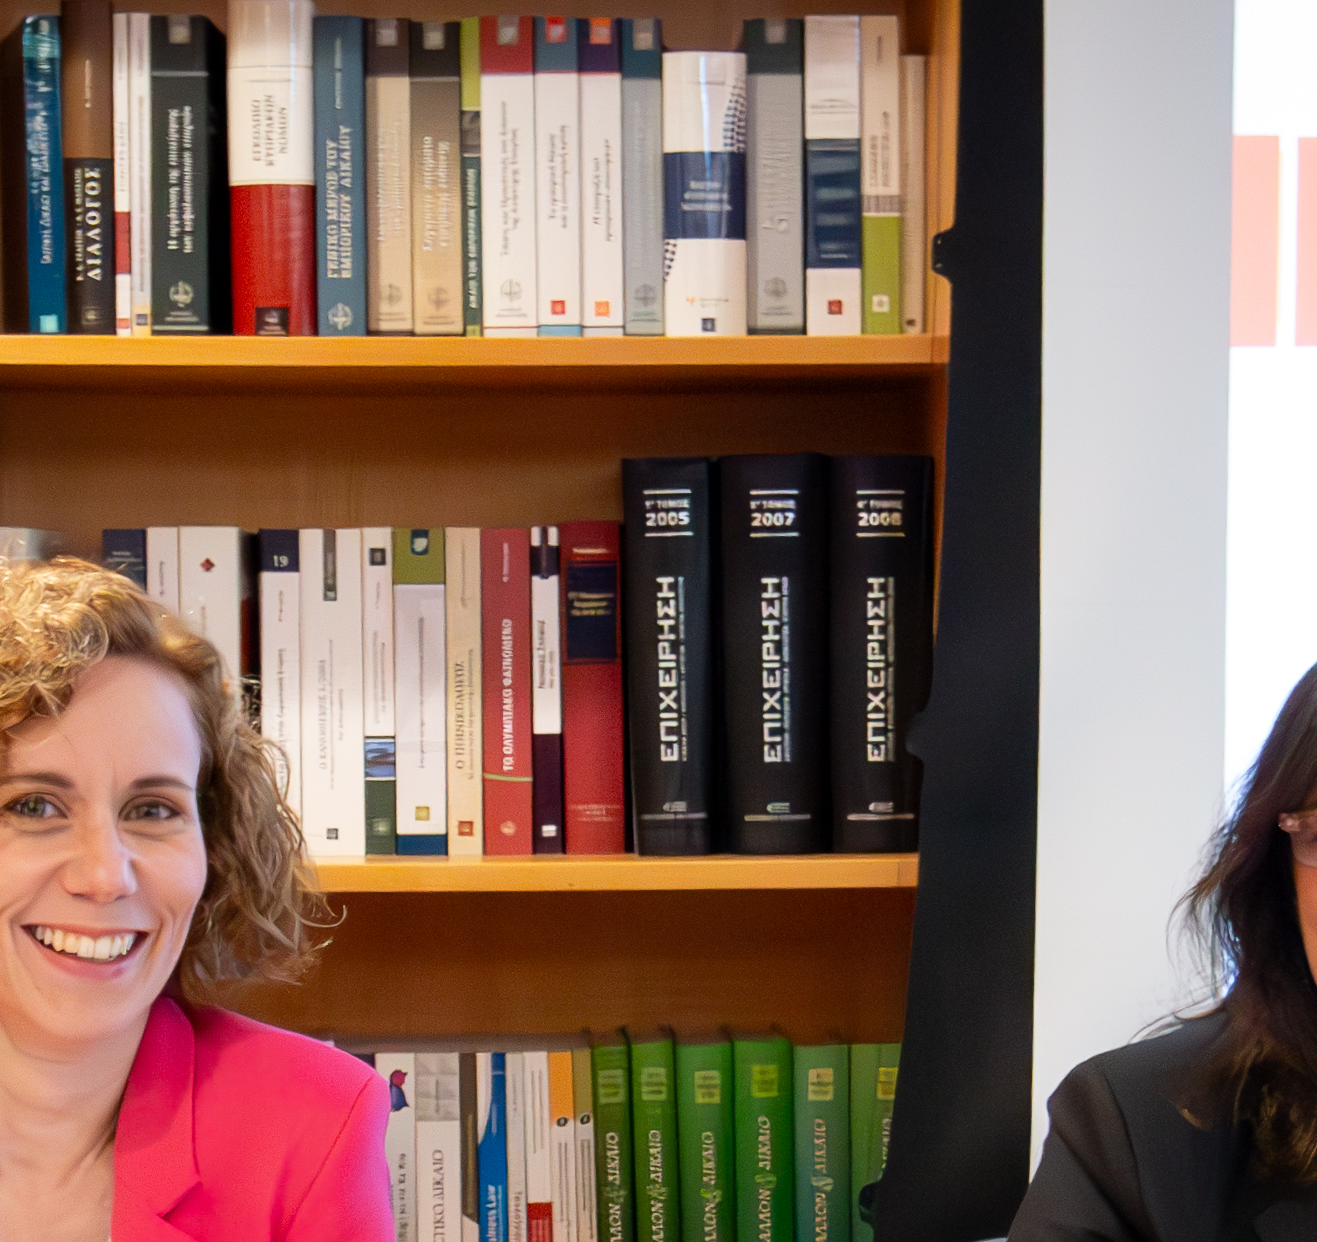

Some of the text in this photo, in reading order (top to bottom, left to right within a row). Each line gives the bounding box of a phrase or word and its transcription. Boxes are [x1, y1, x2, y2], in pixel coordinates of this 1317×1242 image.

[84, 167, 102, 281] ΔΙΑΛΟΓΟΣ
[325, 138, 339, 278] ΓΕΝΙΚΟ ΜΕΡΟΣ ΤΟΥ
[338, 123, 352, 278] ΕΜΠΟΡΙΚΟΥ ΔΙΚΑΙΟΥ
[645, 511, 691, 527] 2005
[750, 511, 796, 527] 2007
[273, 555, 289, 568] 19
[500, 618, 514, 771] ΤΟ ΟΛΥΜΠΙΑΚΟ ΦΑΙΝΟΜΕΝΟ
[656, 576, 679, 762] ΕΠΙΧΕΙΡΗΣΗ
[761, 577, 782, 763] ΕΠΙΧΕΙΡΗΣΗ
[867, 576, 886, 763] ΕΠΙΧΕΙΡΗΣΗ
[605, 1131, 620, 1185] ΔΙΚΑΙΟ
[648, 1129, 663, 1183] ΔΙΚΑΙΟ
[701, 1131, 717, 1186] ΔΙΚΑΙΟ
[757, 1115, 772, 1171] ΔΙΚΑΙΟ
[813, 1117, 827, 1174] ΔΙΚΑΙΟ
[432, 1149, 445, 1202] ΔΙΚΑΙΟ
[484, 1184, 496, 1209] Law
